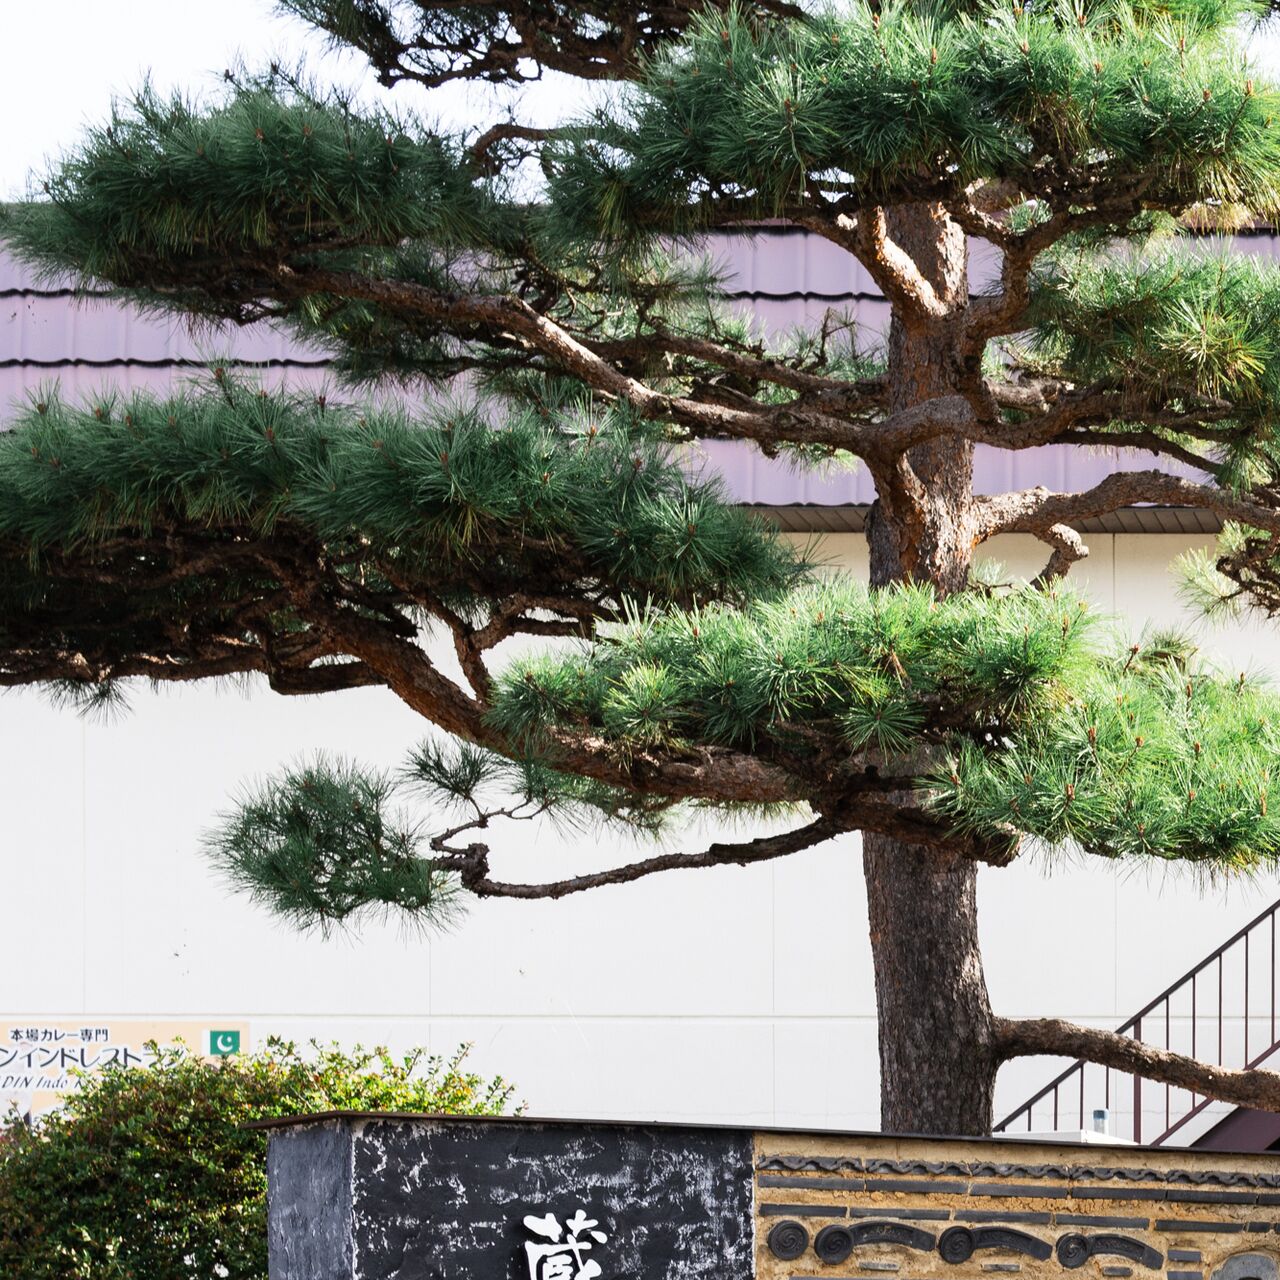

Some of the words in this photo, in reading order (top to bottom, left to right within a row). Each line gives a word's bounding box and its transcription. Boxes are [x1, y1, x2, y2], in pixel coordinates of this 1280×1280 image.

[10, 1028, 109, 1042] 本場カレー専門
[0, 1075, 33, 1089] DIN
[36, 1074, 68, 1089] Indo
